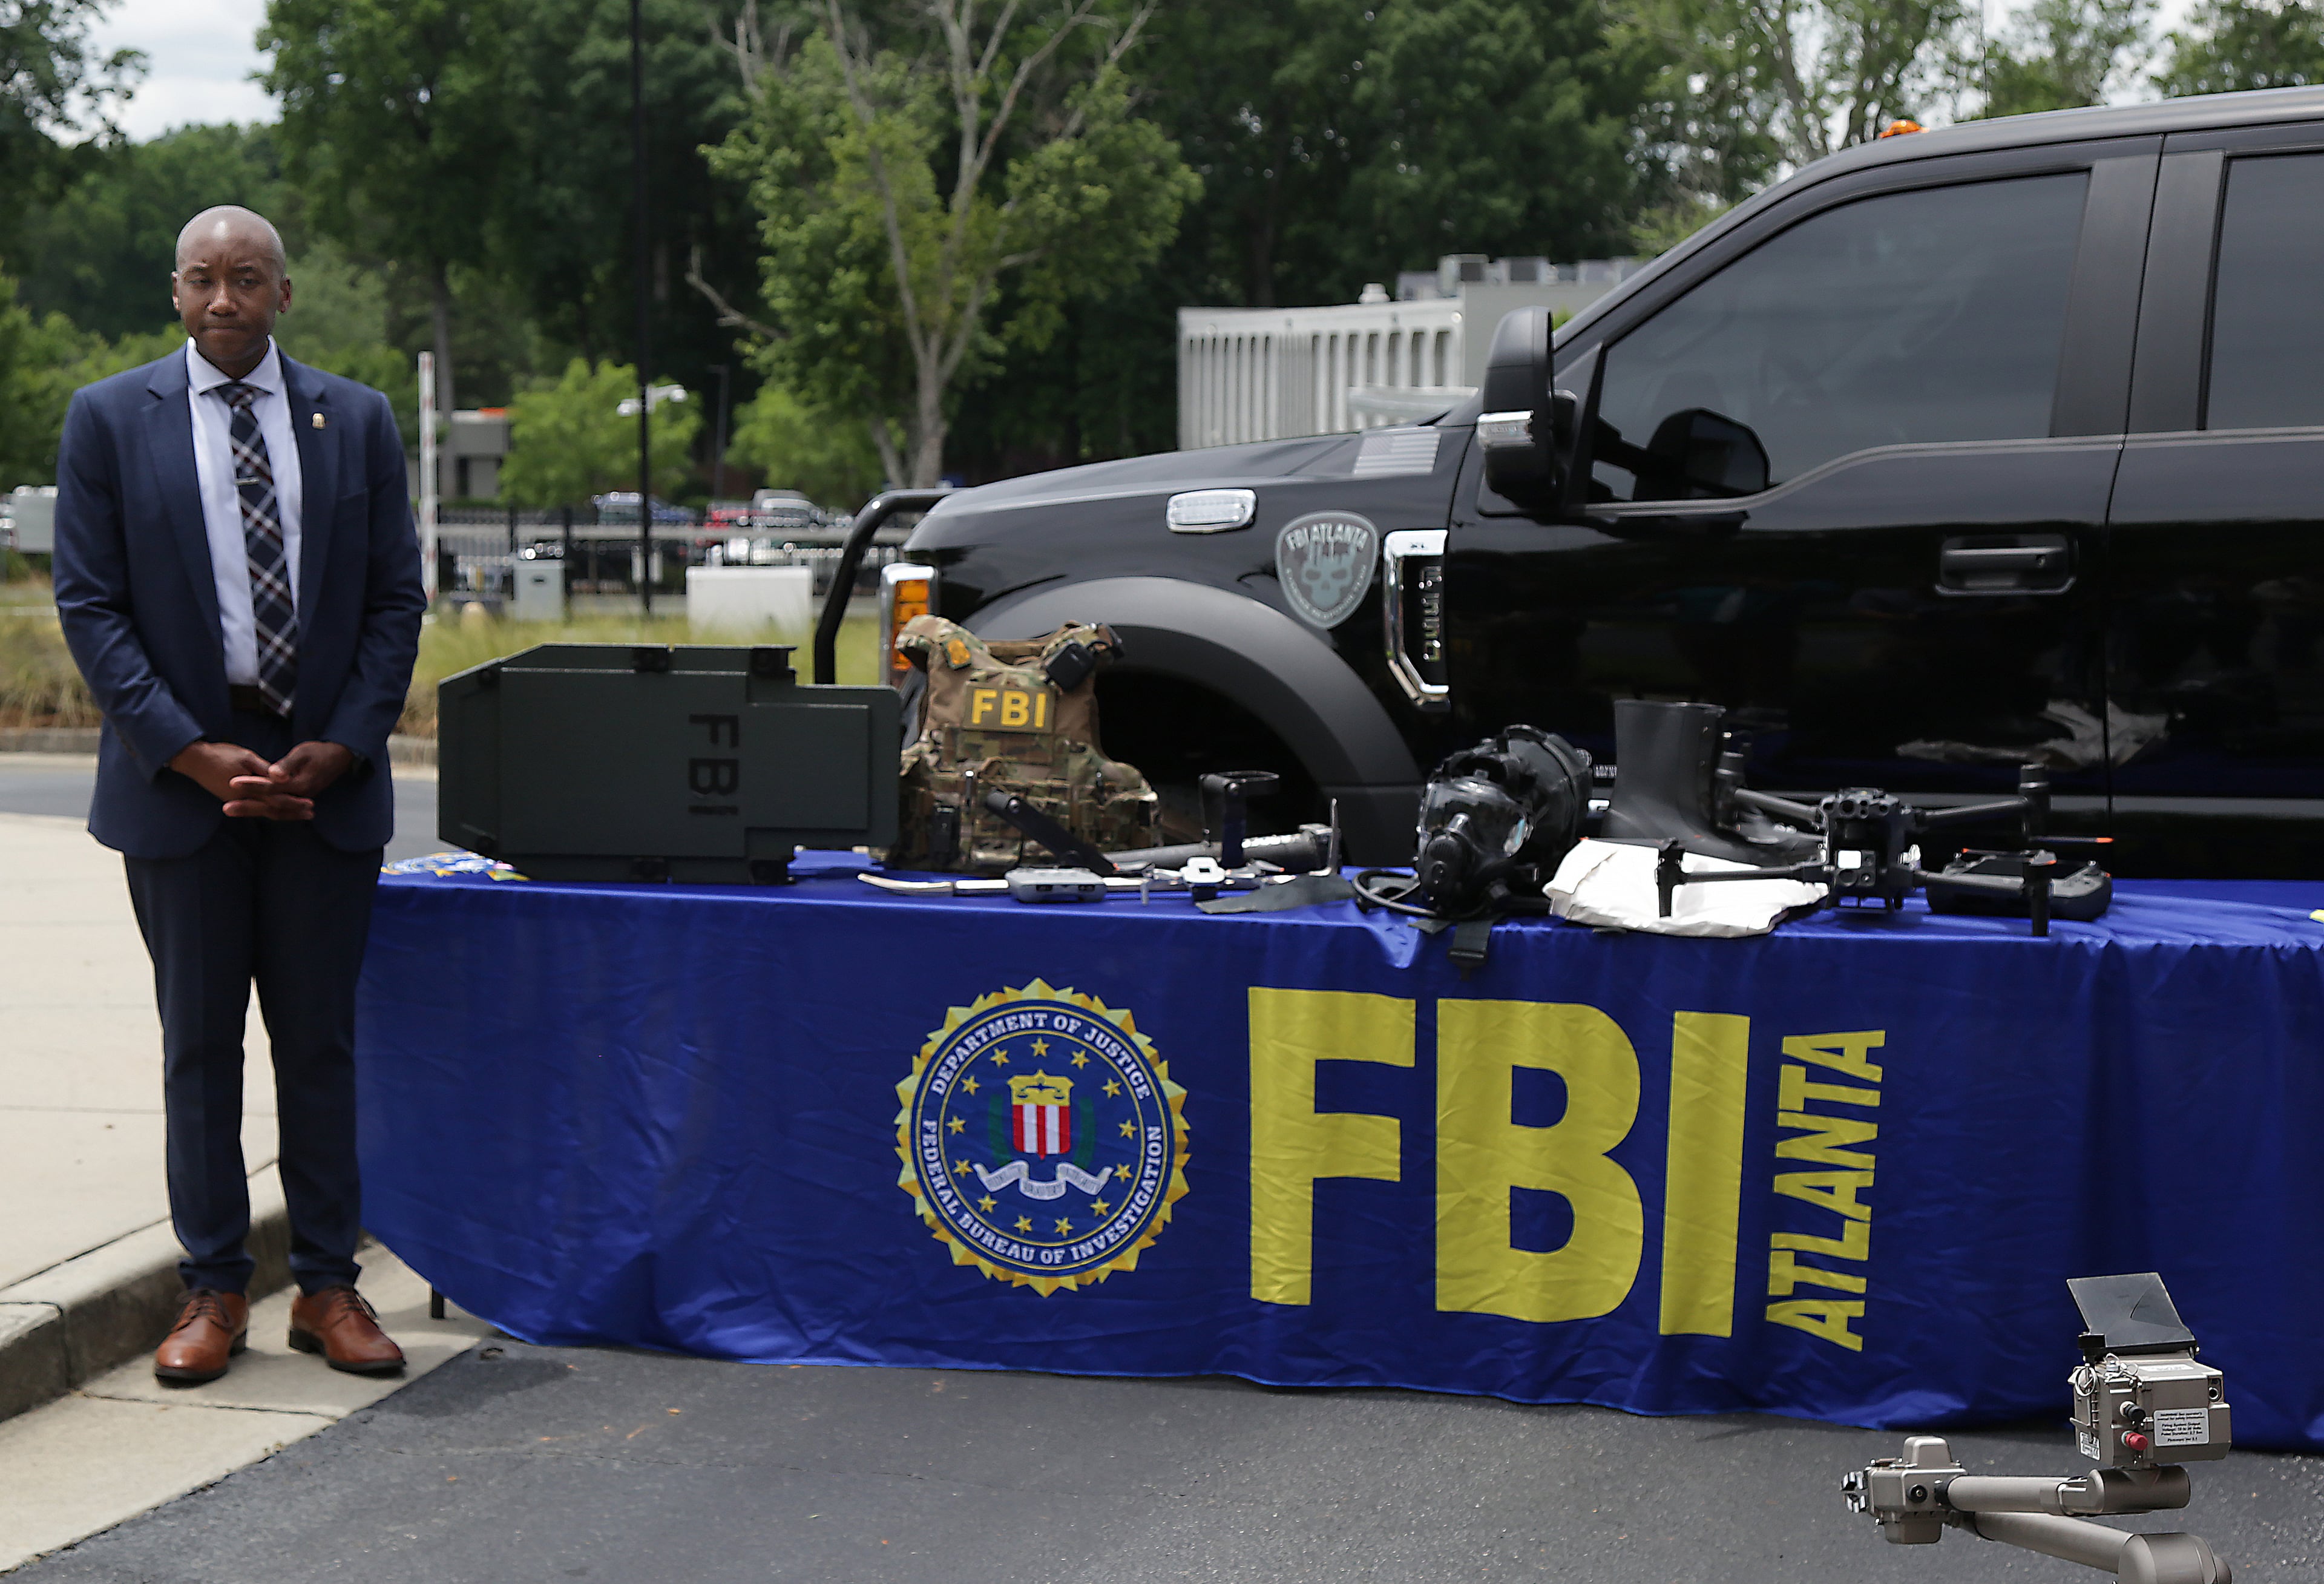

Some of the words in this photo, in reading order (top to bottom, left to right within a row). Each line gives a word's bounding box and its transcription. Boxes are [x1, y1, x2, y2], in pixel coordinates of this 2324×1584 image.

[1284, 527, 1310, 551] FBI
[1310, 523, 1370, 550] ATLANTA
[970, 688, 1048, 729] FBI
[688, 713, 739, 816] FBI
[931, 1012, 1048, 1097] DEPARTMENT
[1053, 1014, 1082, 1036] OF
[1084, 1027, 1152, 1101] JUSTICE
[921, 1119, 959, 1215] FEDERAL
[959, 1213, 1036, 1263] BUREAU
[1040, 1248, 1066, 1264] OF
[1071, 1125, 1164, 1261] INVESTIGATION
[1248, 987, 1750, 1338] FBI
[1765, 1029, 1886, 1352] ATLANTA
